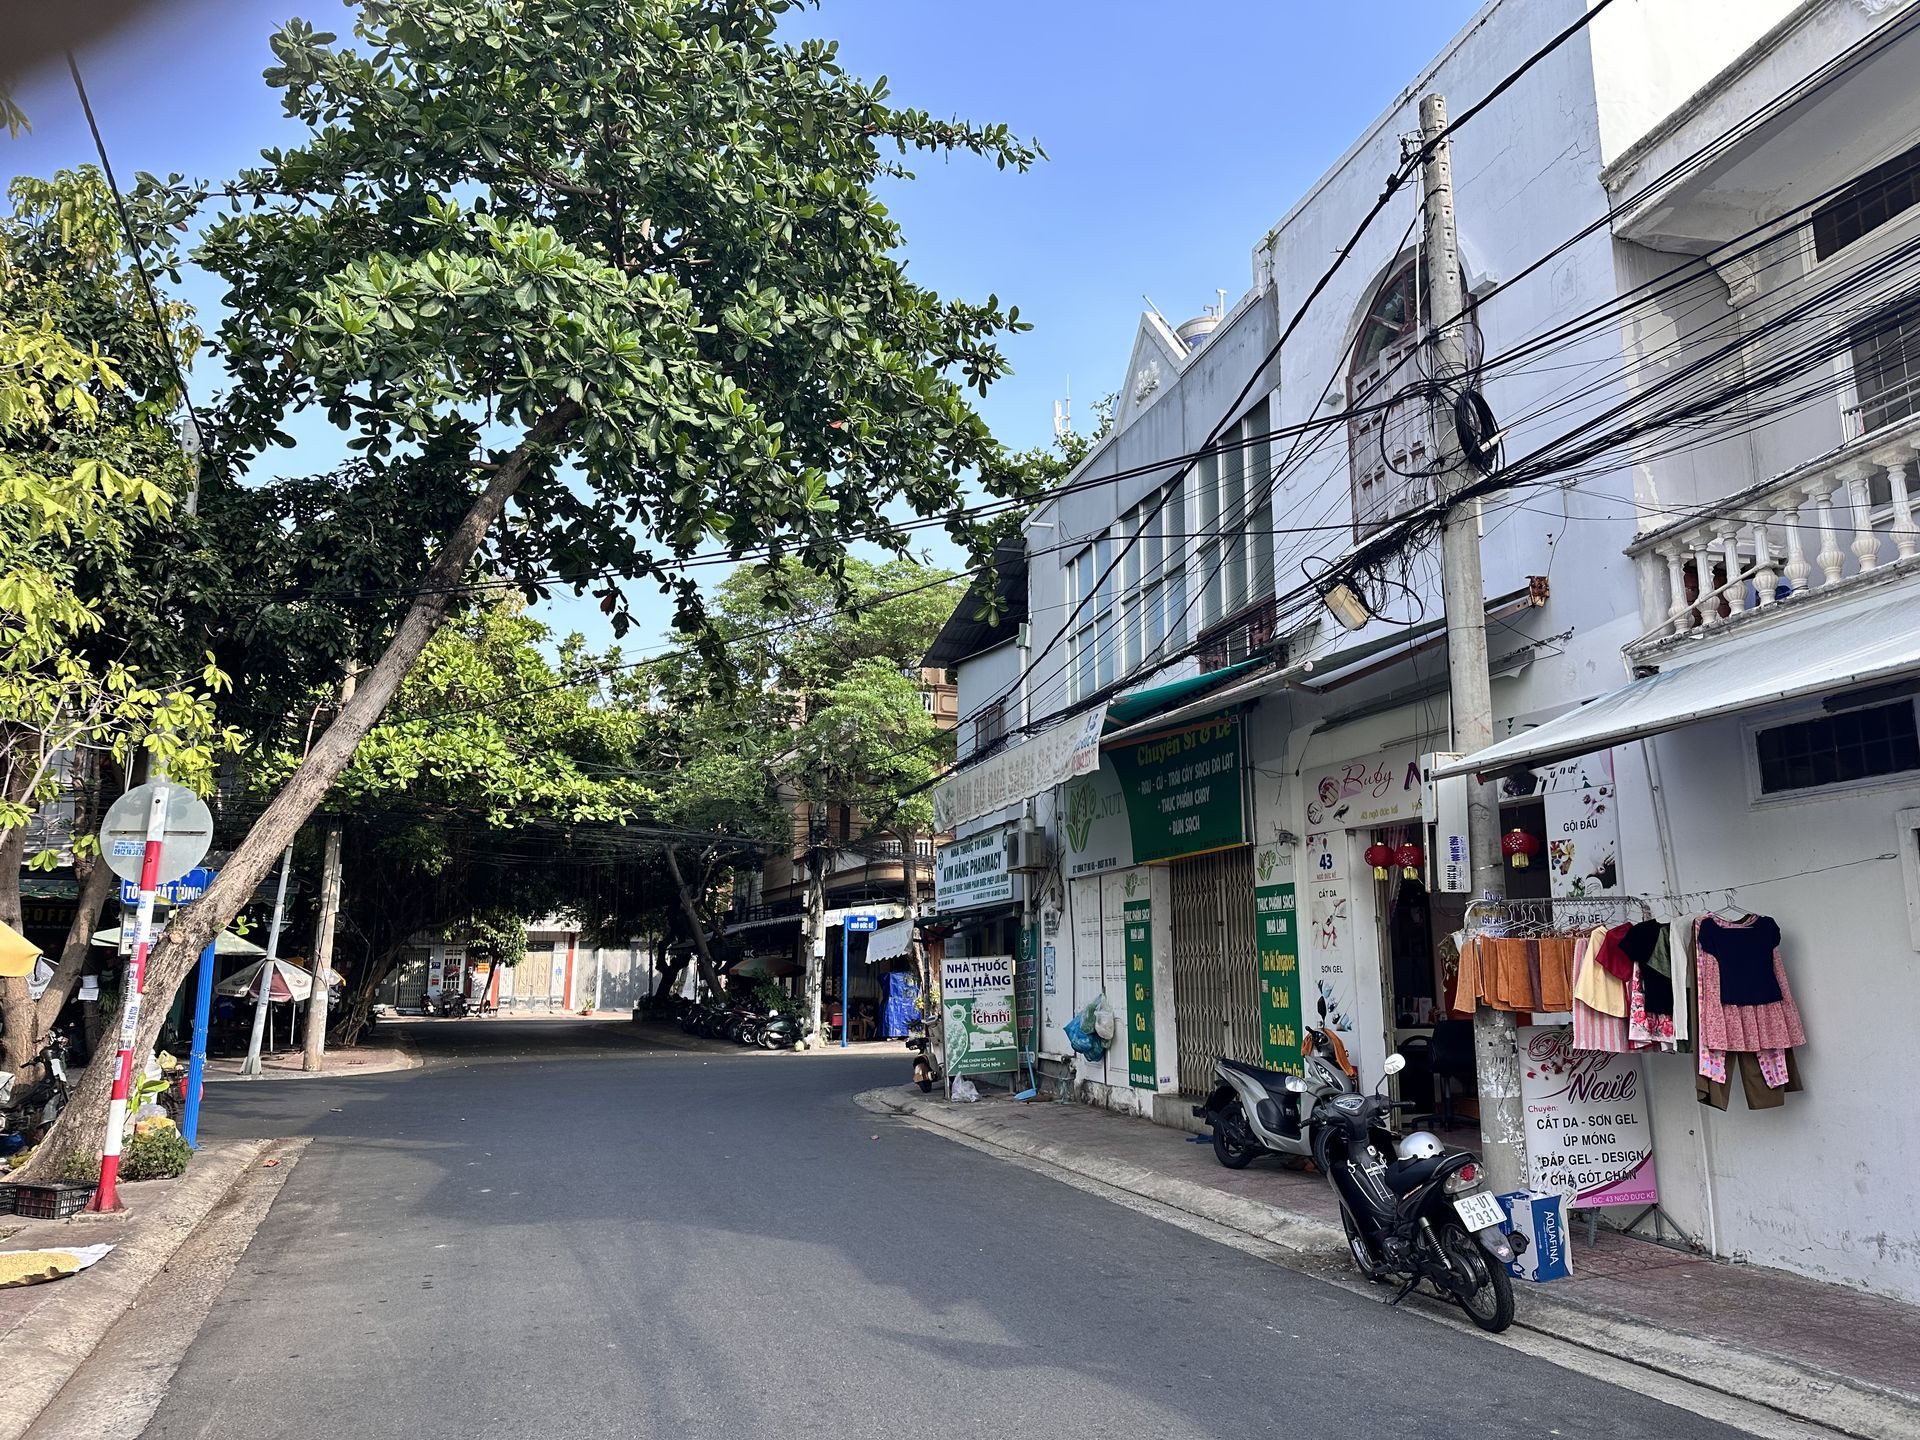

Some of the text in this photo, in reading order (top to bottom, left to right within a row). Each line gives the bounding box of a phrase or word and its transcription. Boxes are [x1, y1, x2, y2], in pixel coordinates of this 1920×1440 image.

[1342, 761, 1394, 798] Ruby
[1194, 786, 1210, 804] CHAY
[943, 865, 954, 883] KIM
[970, 851, 1002, 876] PHARMACY
[1319, 853, 1333, 870] 43
[947, 961, 969, 974] NHÀ
[971, 958, 1008, 972] THUỐC
[1321, 964, 1343, 974] SƠN GEL
[945, 977, 970, 989] KIM
[972, 973, 1011, 988] HẰNG
[1132, 1042, 1142, 1061] Kim
[1568, 1070, 1638, 1104] Nail
[1528, 1105, 1559, 1114] Chuyên:
[1537, 1114, 1638, 1130] CẮT DA SƠN GEL
[1563, 1132, 1616, 1147] ÚP MÓNG
[1542, 1150, 1644, 1167] ĐẮP GEL DESIGN
[1578, 1169, 1602, 1183] GÓT
[1605, 1167, 1637, 1182] CHÂN
[1461, 1195, 1492, 1215] 54-U1
[1605, 1195, 1614, 1203] 43
[1614, 1194, 1630, 1202] NGÔ
[1468, 1207, 1499, 1229] 7931
[1544, 1211, 1559, 1266] AQUAFINA
